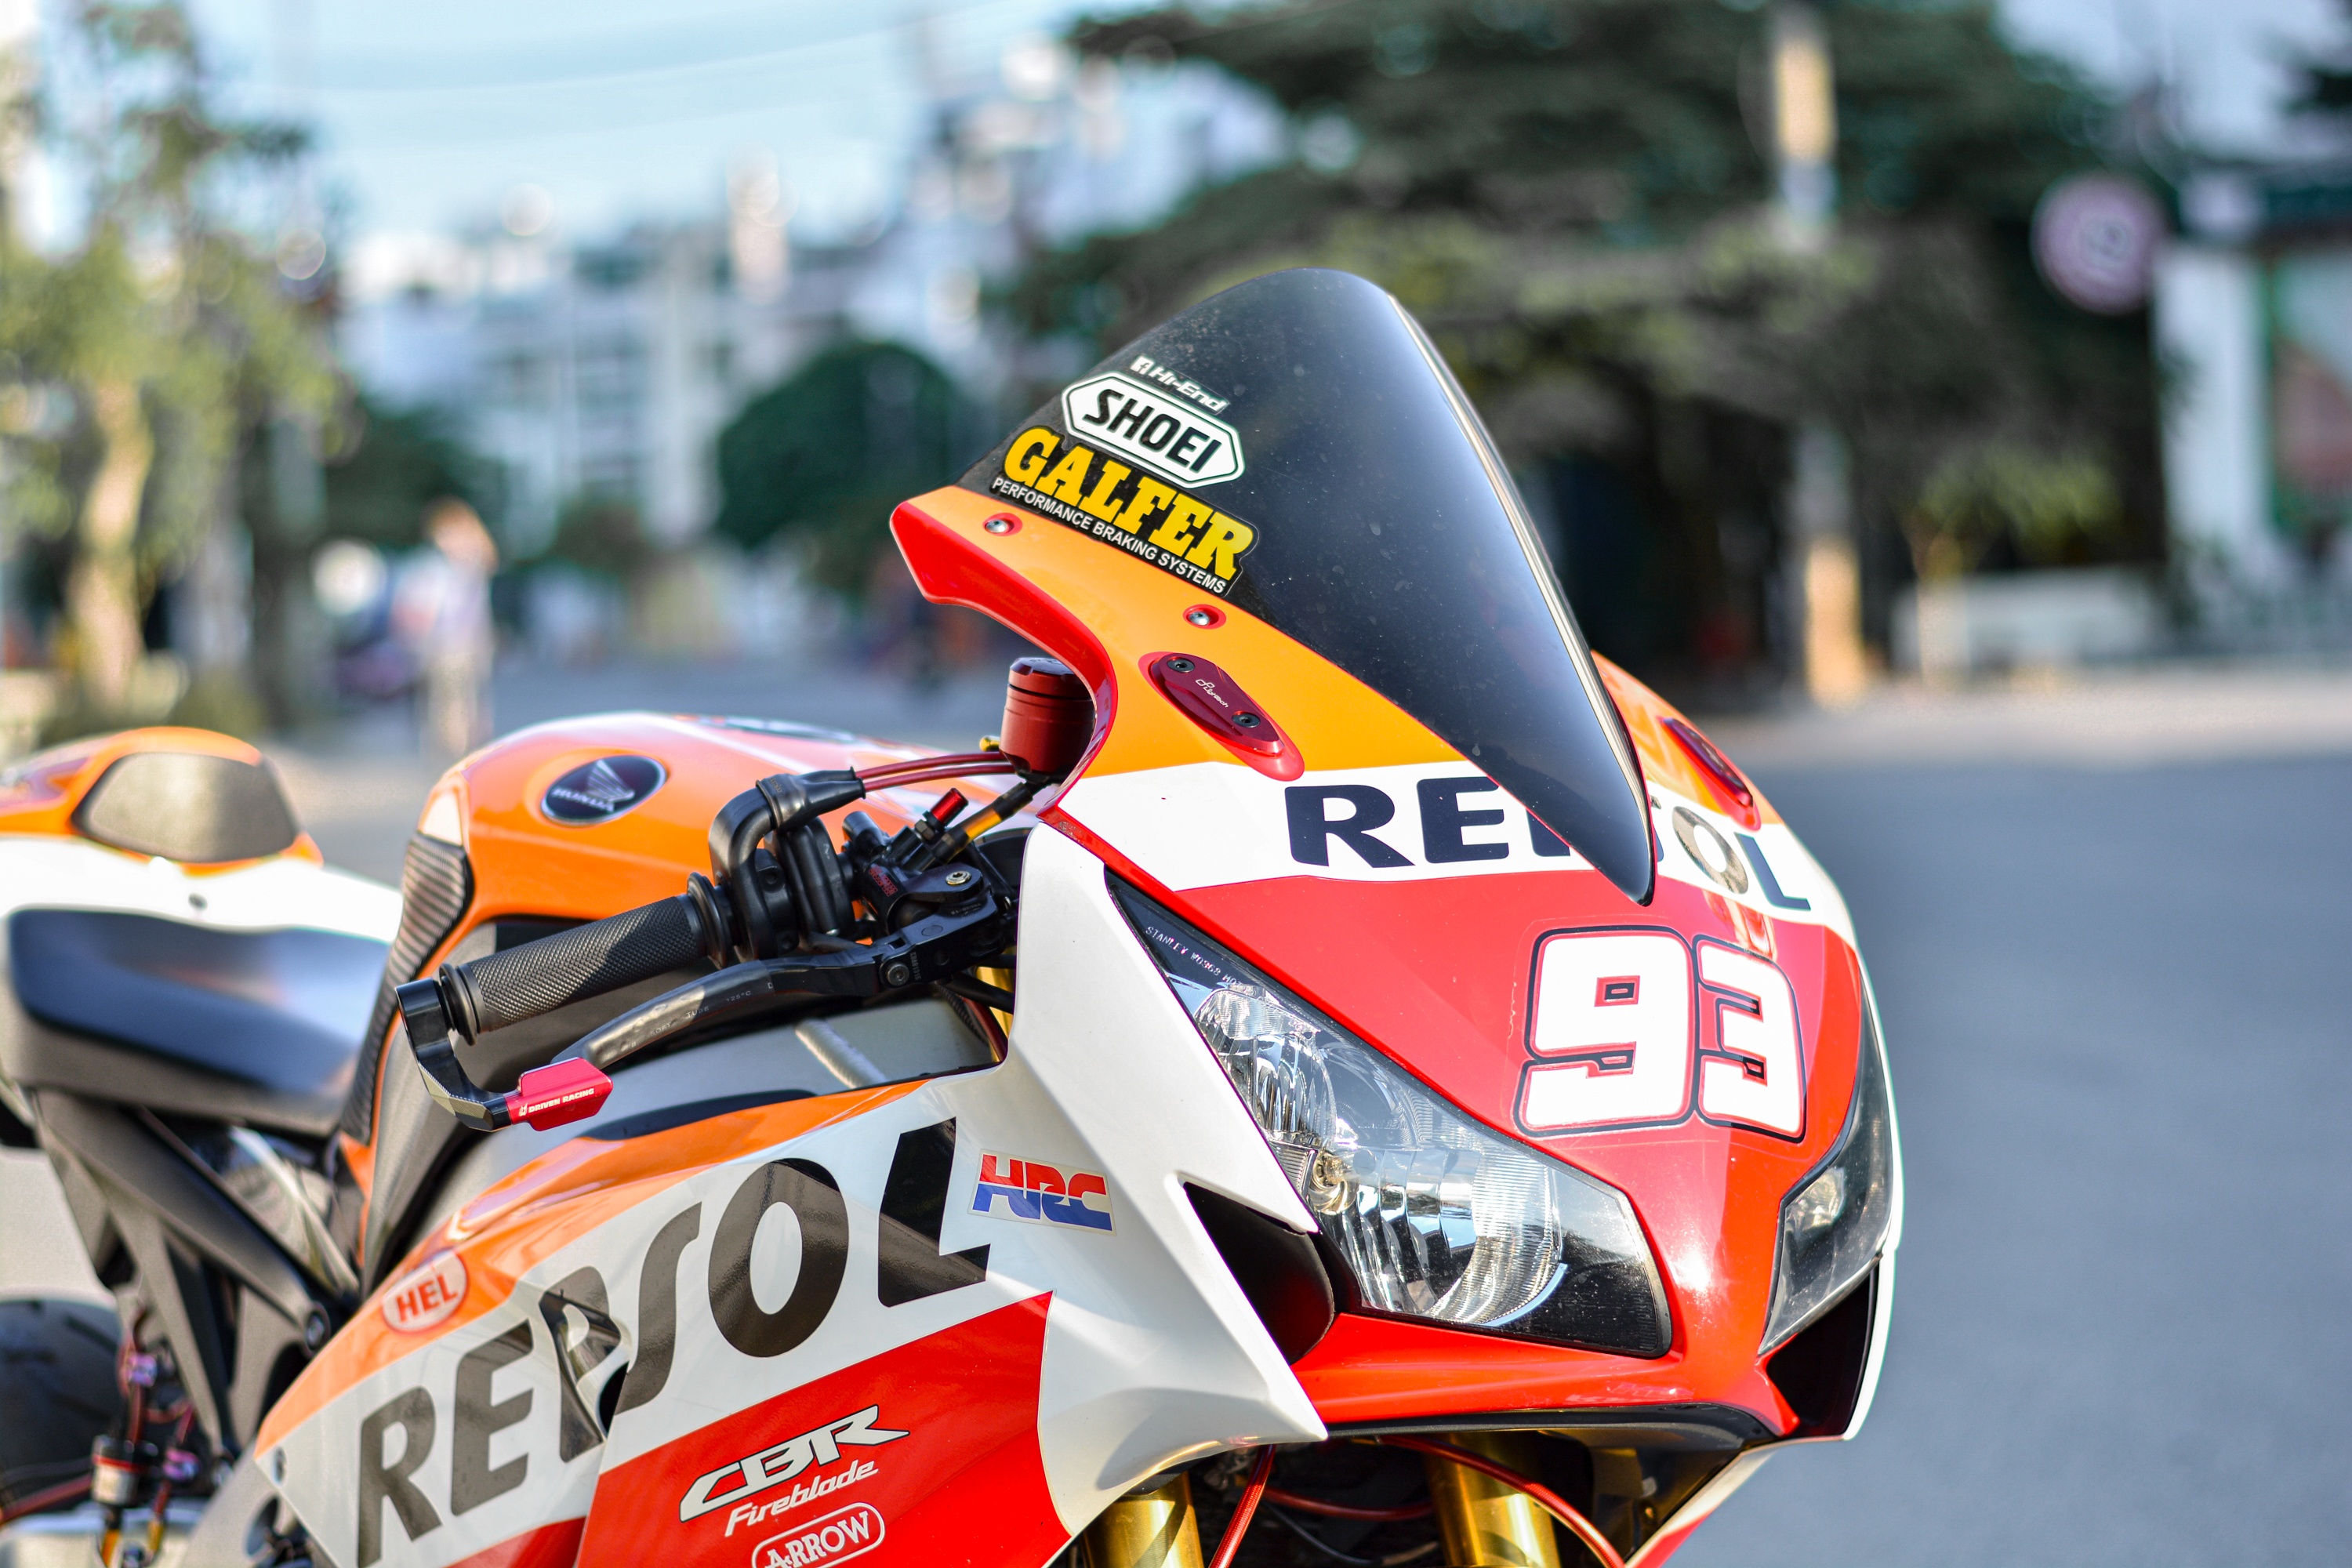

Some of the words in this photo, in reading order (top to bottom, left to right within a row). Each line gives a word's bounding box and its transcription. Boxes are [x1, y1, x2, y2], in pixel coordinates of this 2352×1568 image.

[1081, 389, 1222, 474] SHOEI
[992, 477, 1091, 530] PERFORMANCE
[1092, 521, 1156, 561] BRAKING
[1158, 554, 1226, 594] SYSTEMS
[1004, 426, 1254, 581] GALFER
[1284, 776, 1811, 912] REOL
[1145, 926, 1189, 955] STANLEY
[1515, 925, 1808, 1143] 93
[528, 1098, 561, 1113] DRIVEN
[562, 1087, 595, 1103] RACING
[972, 1153, 1112, 1231] HRC
[395, 1273, 458, 1324] HEL
[358, 1116, 990, 1568] REPSOL
[679, 1403, 910, 1523] CBR
[724, 1459, 879, 1537] Fireblade
[764, 1510, 869, 1568] ARROW
